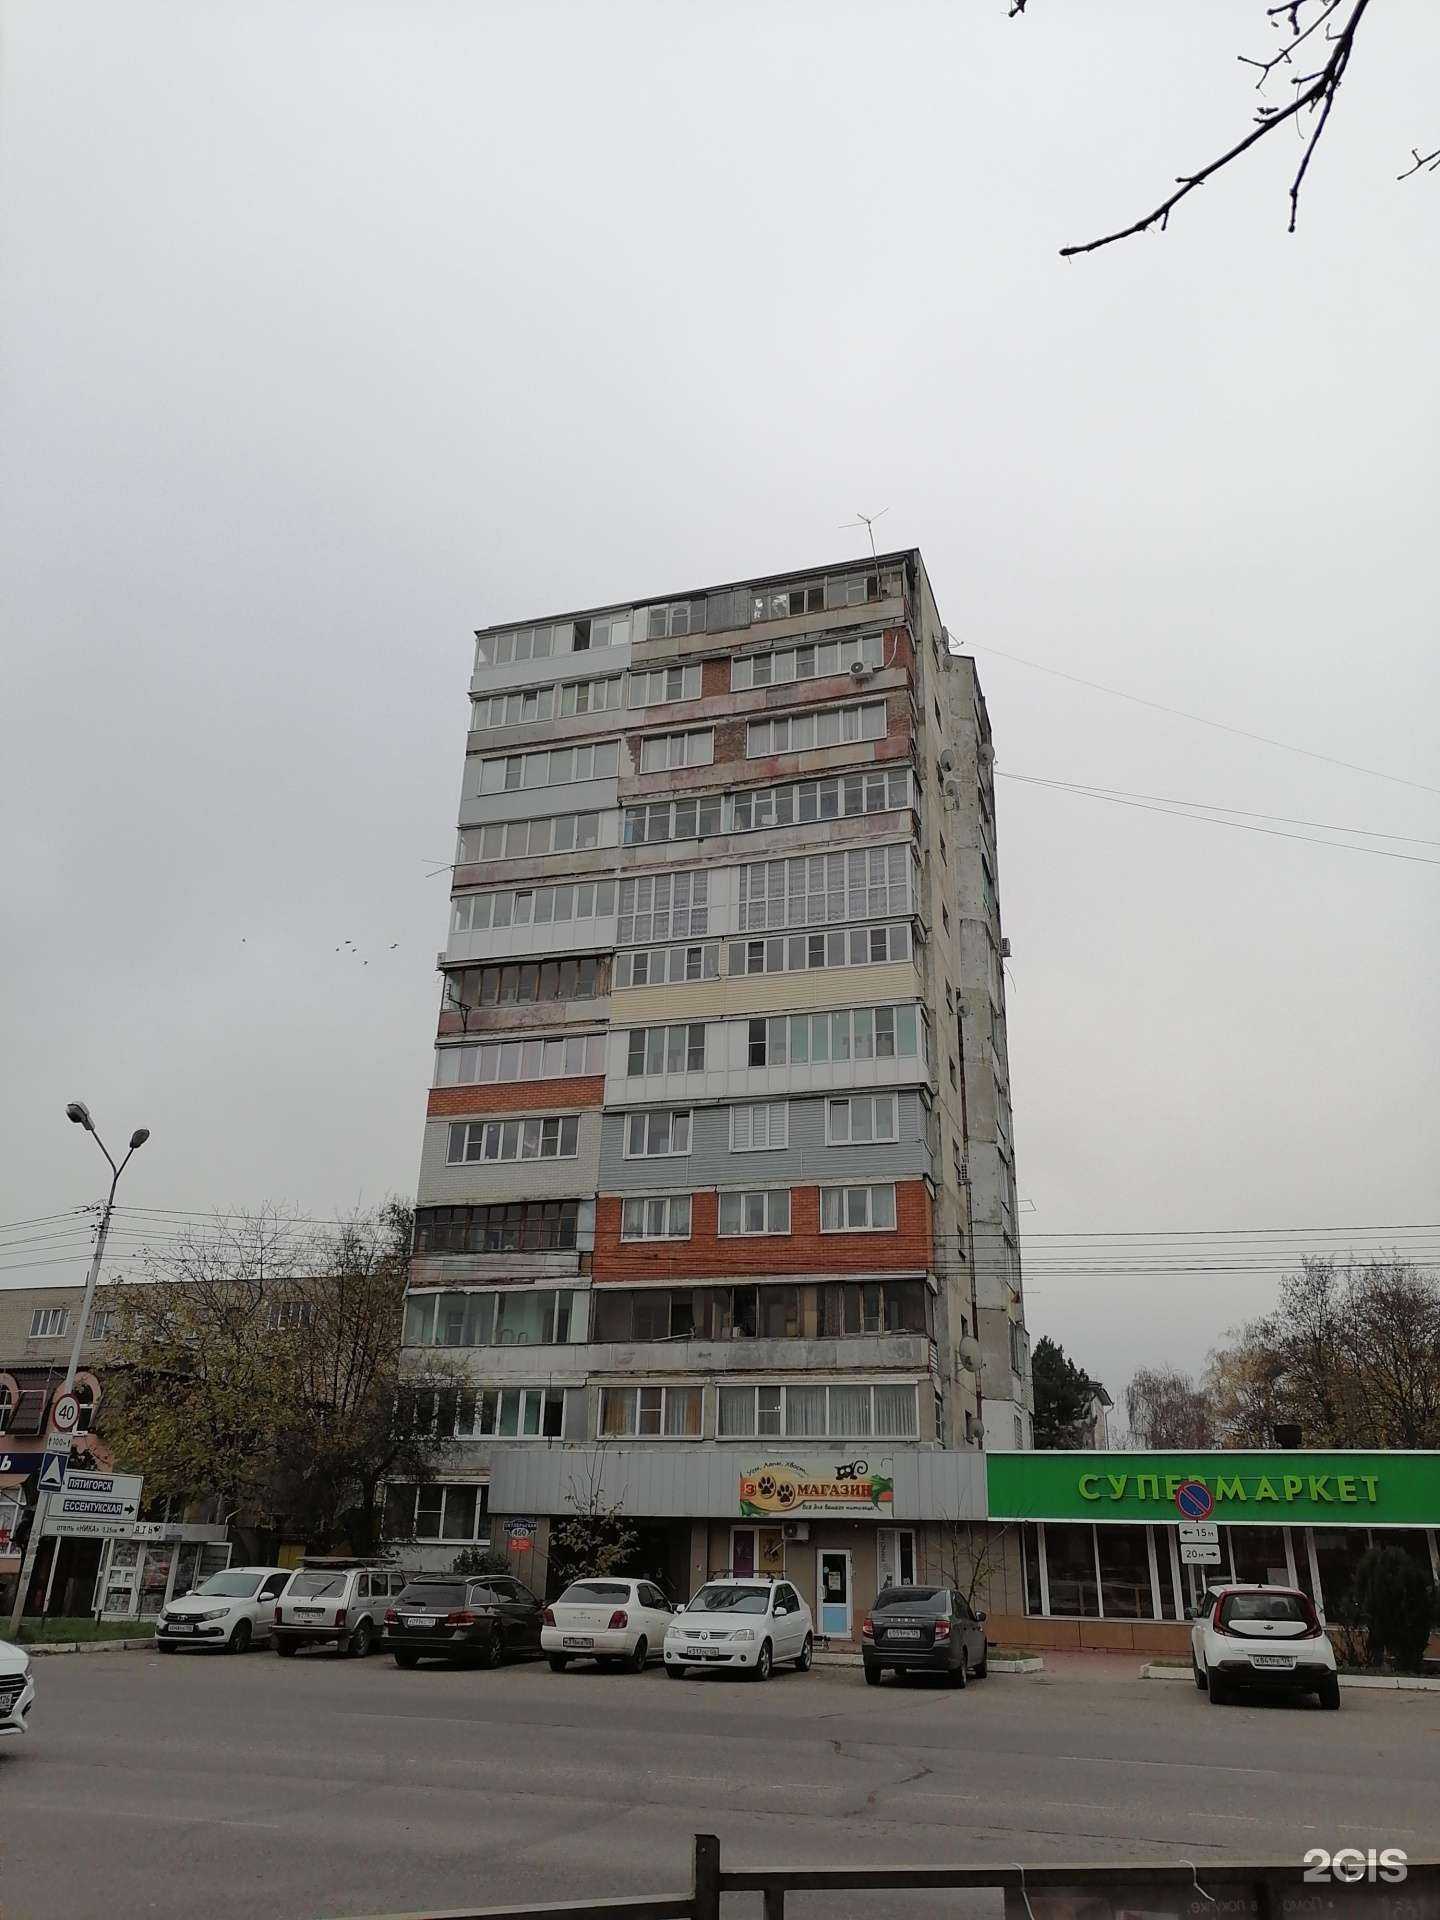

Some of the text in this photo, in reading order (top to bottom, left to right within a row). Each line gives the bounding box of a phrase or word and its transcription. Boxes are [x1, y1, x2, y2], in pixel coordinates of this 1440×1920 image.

[59, 1405, 74, 1420] 40
[68, 1479, 113, 1491] ПЯТИГОРСК
[64, 1500, 122, 1514] ЕССЕНТУКСКАЯ
